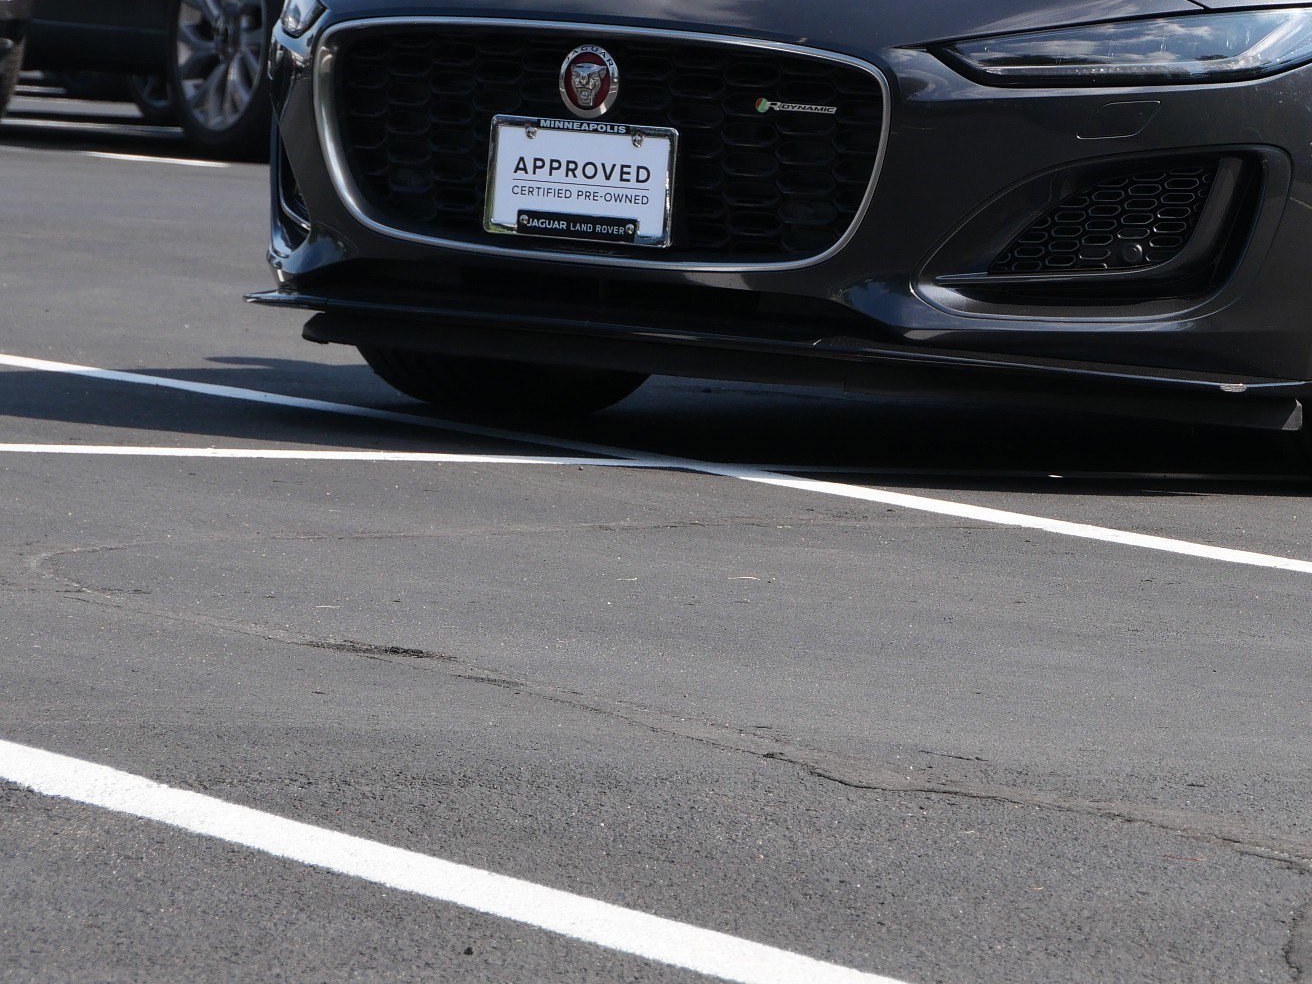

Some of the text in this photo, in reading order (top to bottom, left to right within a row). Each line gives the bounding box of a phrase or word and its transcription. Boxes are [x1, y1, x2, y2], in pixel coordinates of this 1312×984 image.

[566, 45, 614, 67] JAGUAR
[540, 119, 627, 134] MINNEAPOLIS
[513, 156, 651, 184] APPROVED
[511, 184, 650, 205] CERTIFIED PRE-OWNED
[526, 218, 625, 235] JAGUAR LAND ROVER
